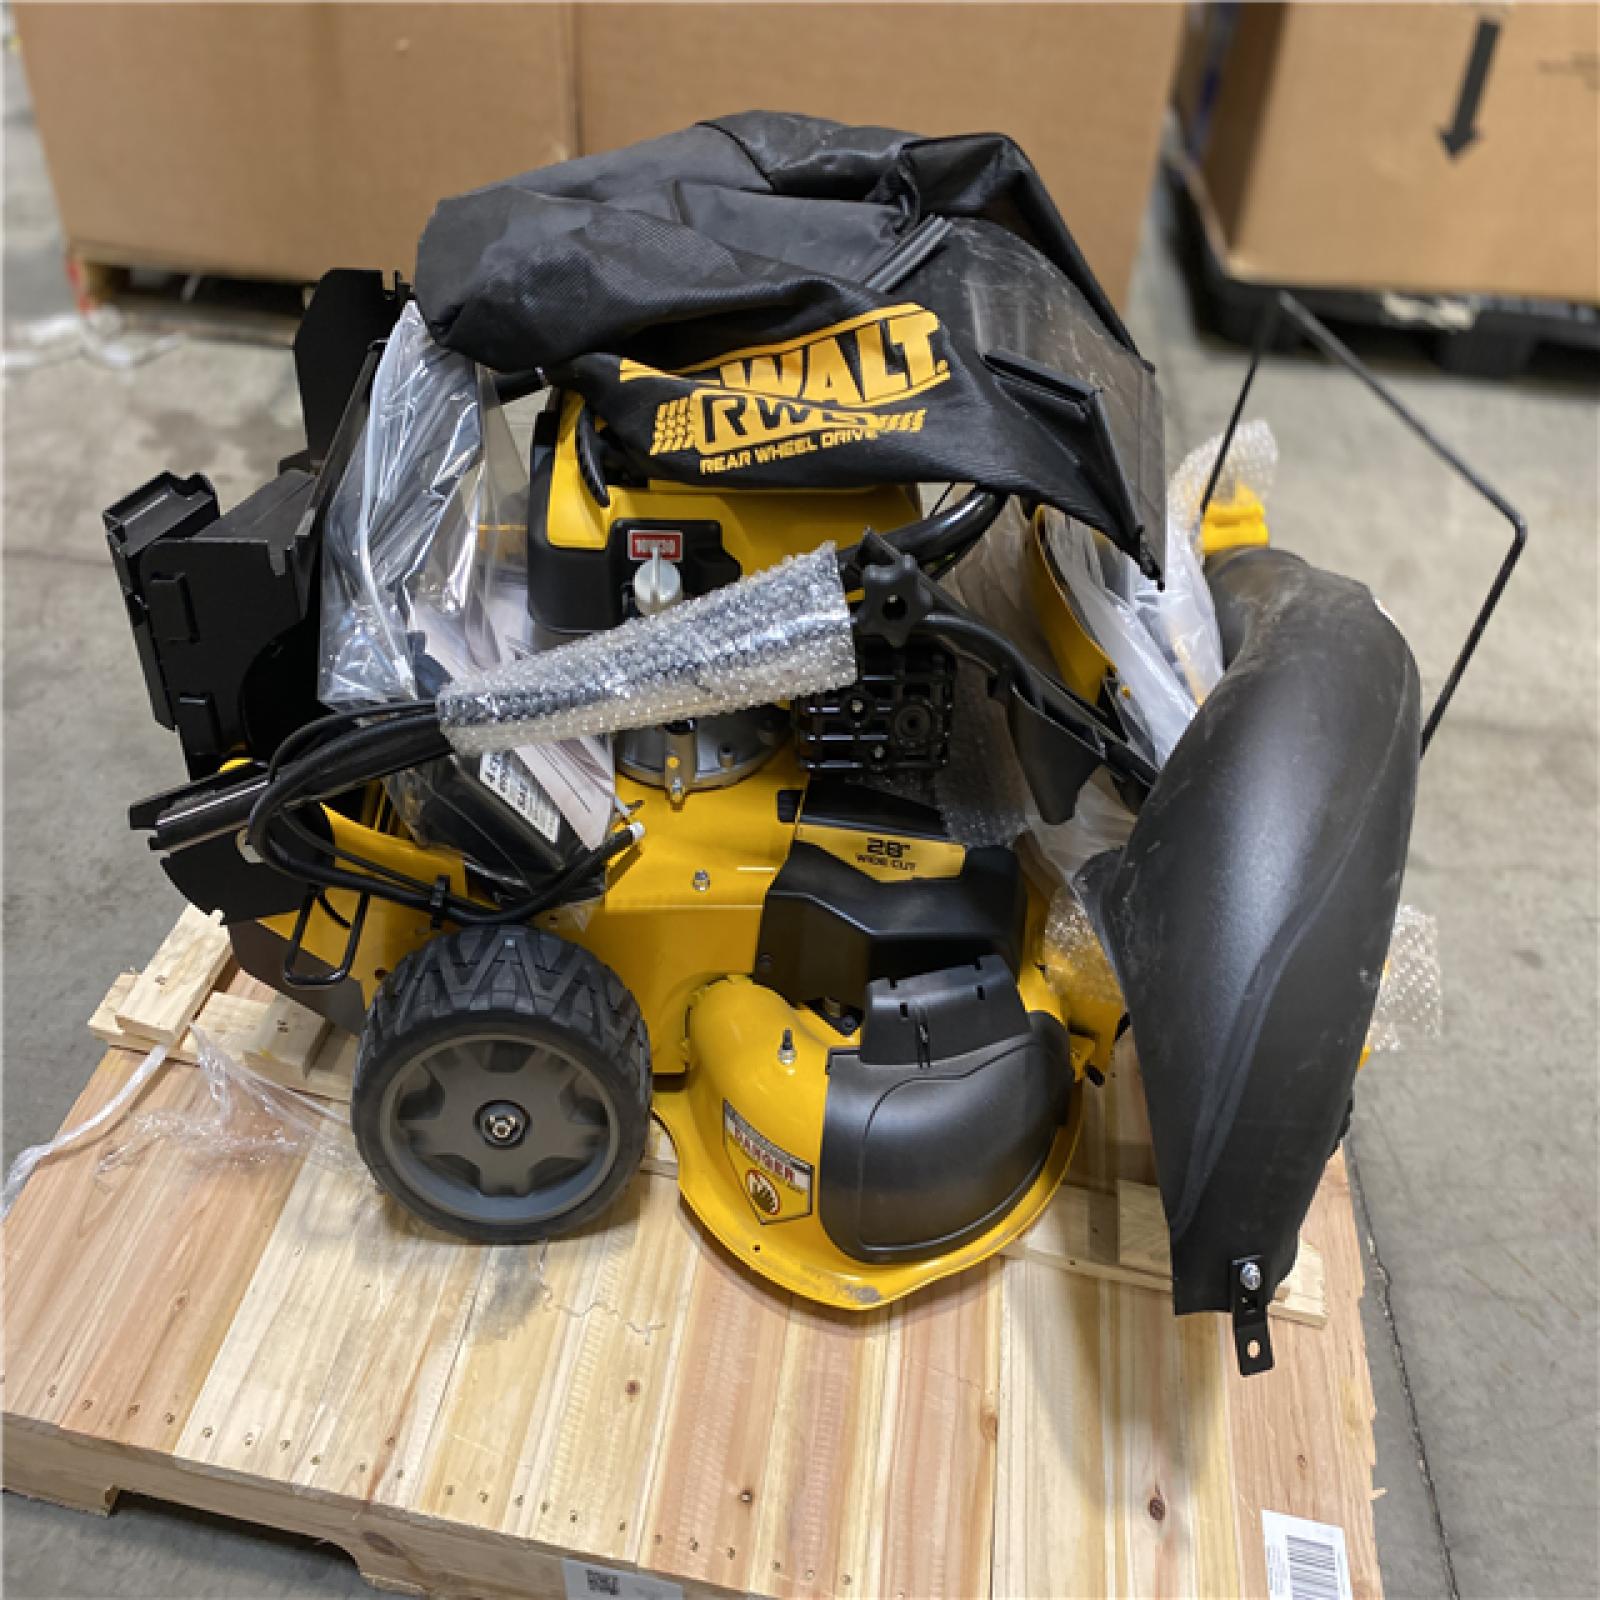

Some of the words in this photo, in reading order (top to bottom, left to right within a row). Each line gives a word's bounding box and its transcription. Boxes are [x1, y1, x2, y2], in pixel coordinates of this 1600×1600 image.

[700, 450, 751, 475] REAR
[754, 437, 818, 464] WHEEL
[821, 428, 878, 447] DRIVE
[857, 854, 888, 865] WIDE
[891, 859, 915, 870] CUT
[735, 1123, 795, 1183] DANGER
